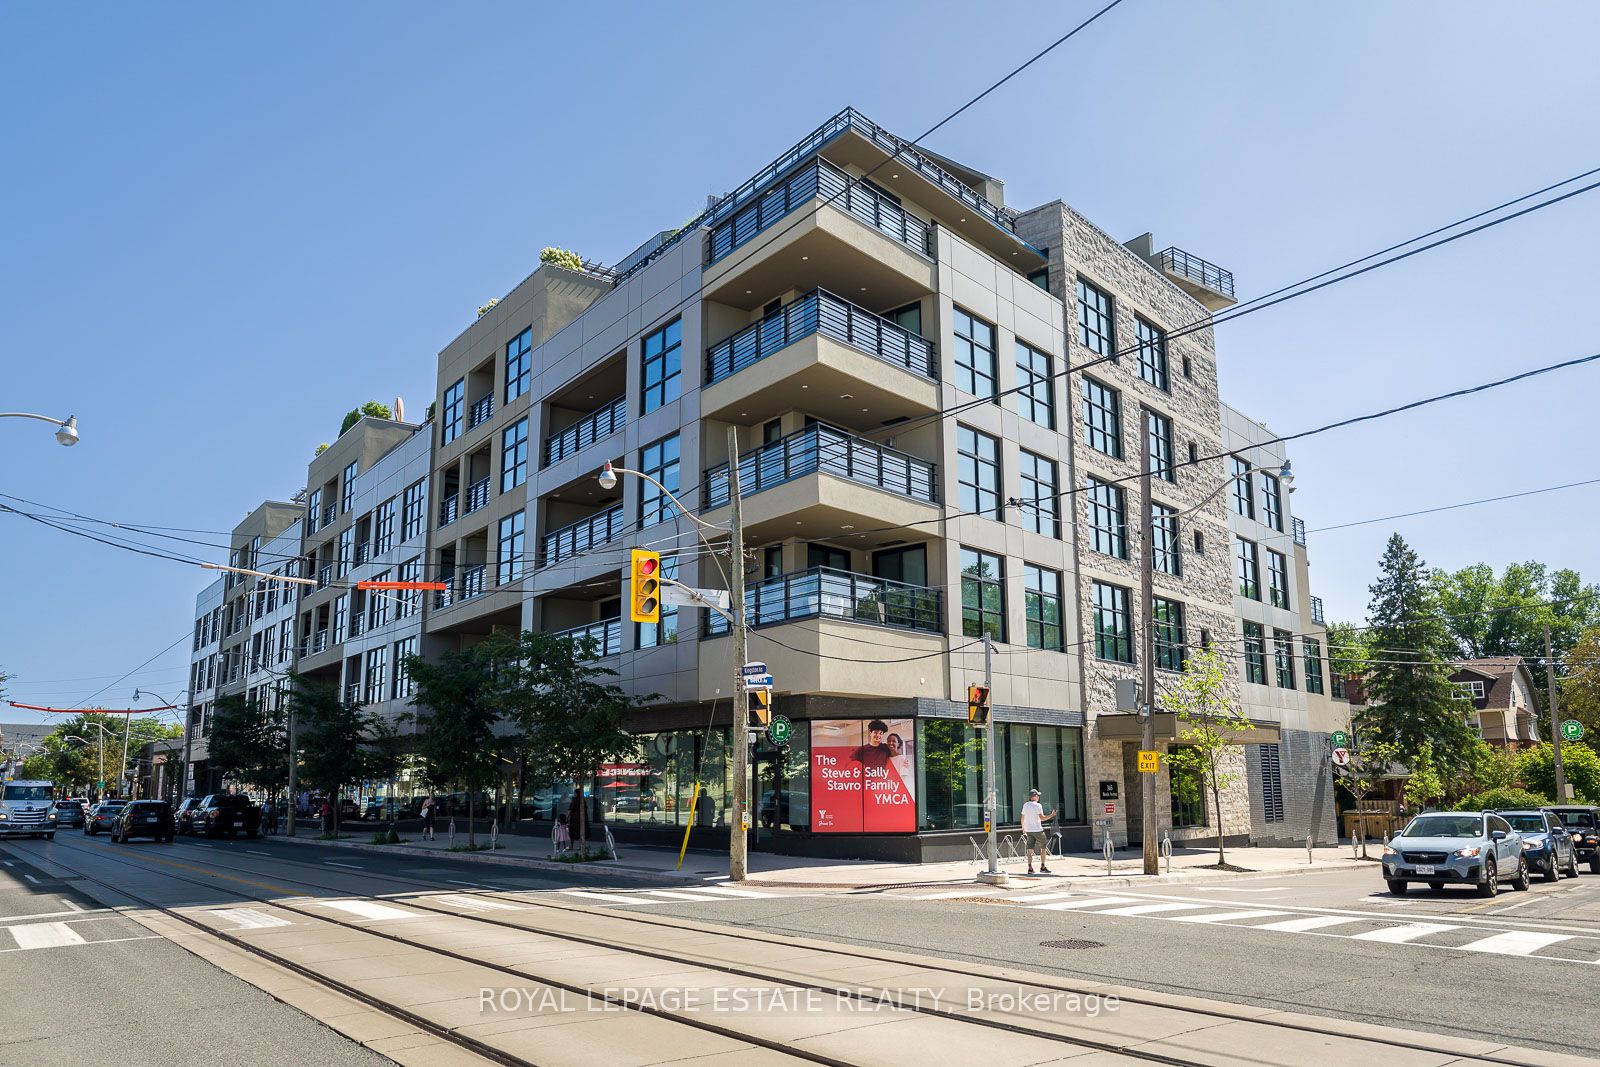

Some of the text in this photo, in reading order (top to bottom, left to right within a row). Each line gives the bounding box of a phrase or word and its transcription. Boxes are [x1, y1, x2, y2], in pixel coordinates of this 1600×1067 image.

[776, 722, 786, 736] P
[1567, 725, 1577, 734] P
[1335, 734, 1344, 742] P
[815, 754, 837, 766] The
[1143, 753, 1153, 761] NO
[821, 766, 890, 780] Steve & Sally
[827, 779, 900, 793] Stavro Family
[874, 793, 909, 805] YMCA
